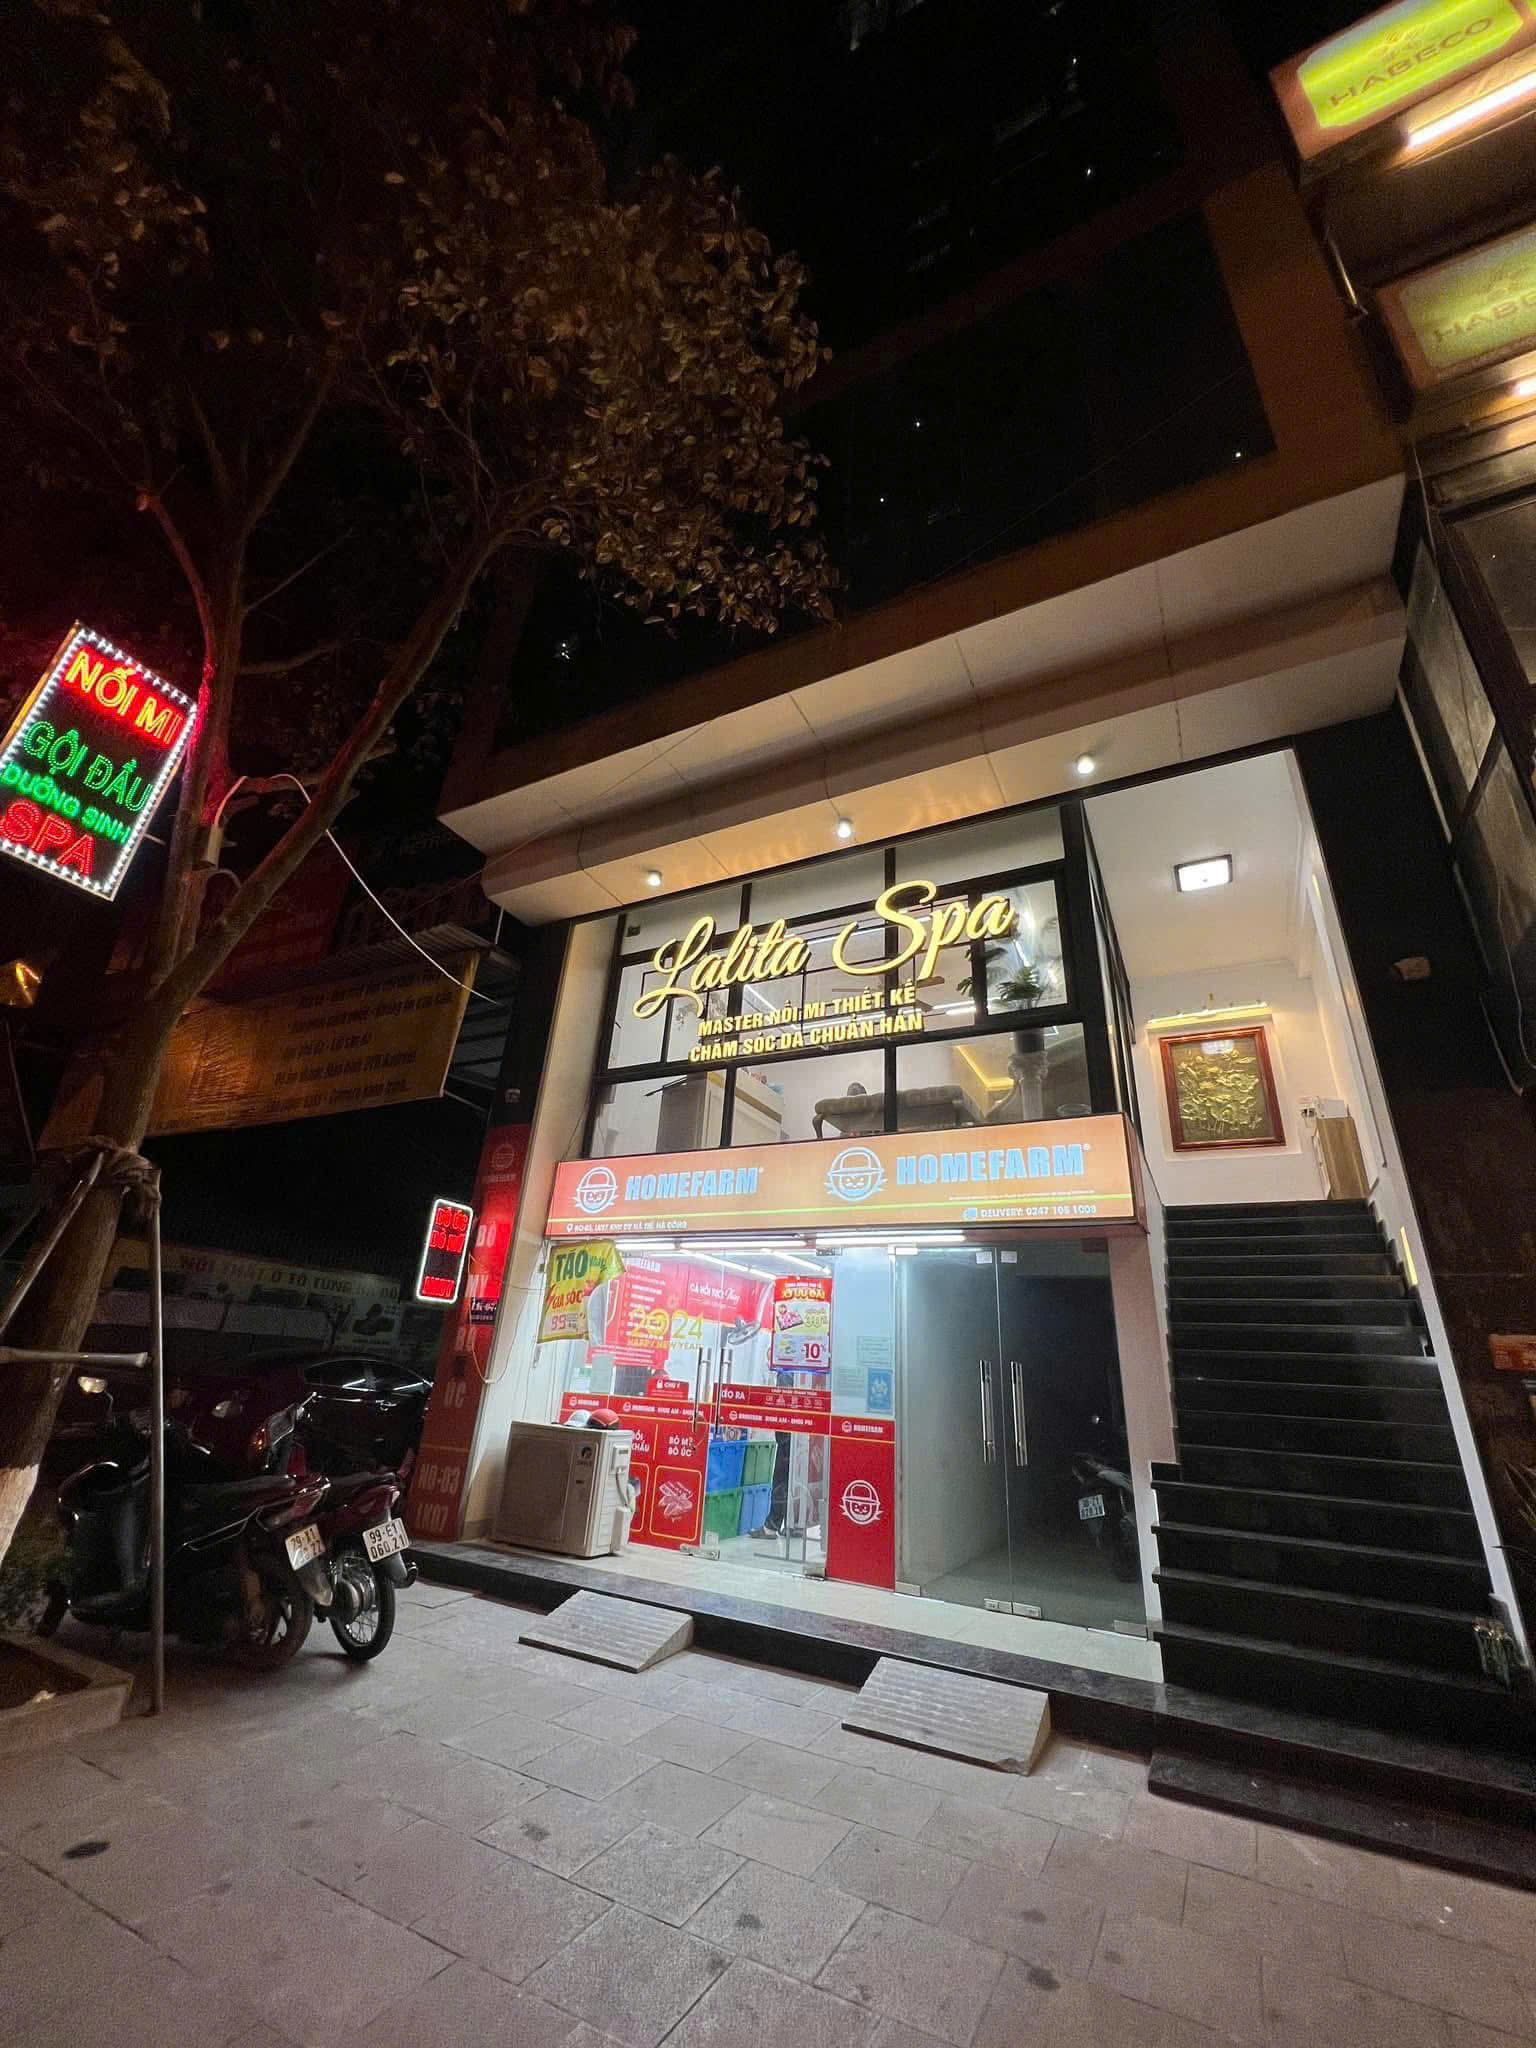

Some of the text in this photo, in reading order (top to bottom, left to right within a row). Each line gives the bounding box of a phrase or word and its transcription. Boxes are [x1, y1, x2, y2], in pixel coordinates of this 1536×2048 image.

[1329, 17, 1493, 107] HABECO
[65, 651, 186, 745] NỐI MI
[24, 721, 89, 777] GỘI
[0, 802, 94, 875] SPA
[81, 806, 132, 844] SINH
[633, 880, 1015, 1018] Lalita Spa
[697, 1015, 766, 1037] MASTER
[804, 1002, 826, 1019] MI
[780, 1033, 804, 1049] DA
[624, 1167, 759, 1201] HOMEFARM
[896, 1143, 1085, 1185] HOMEFARM
